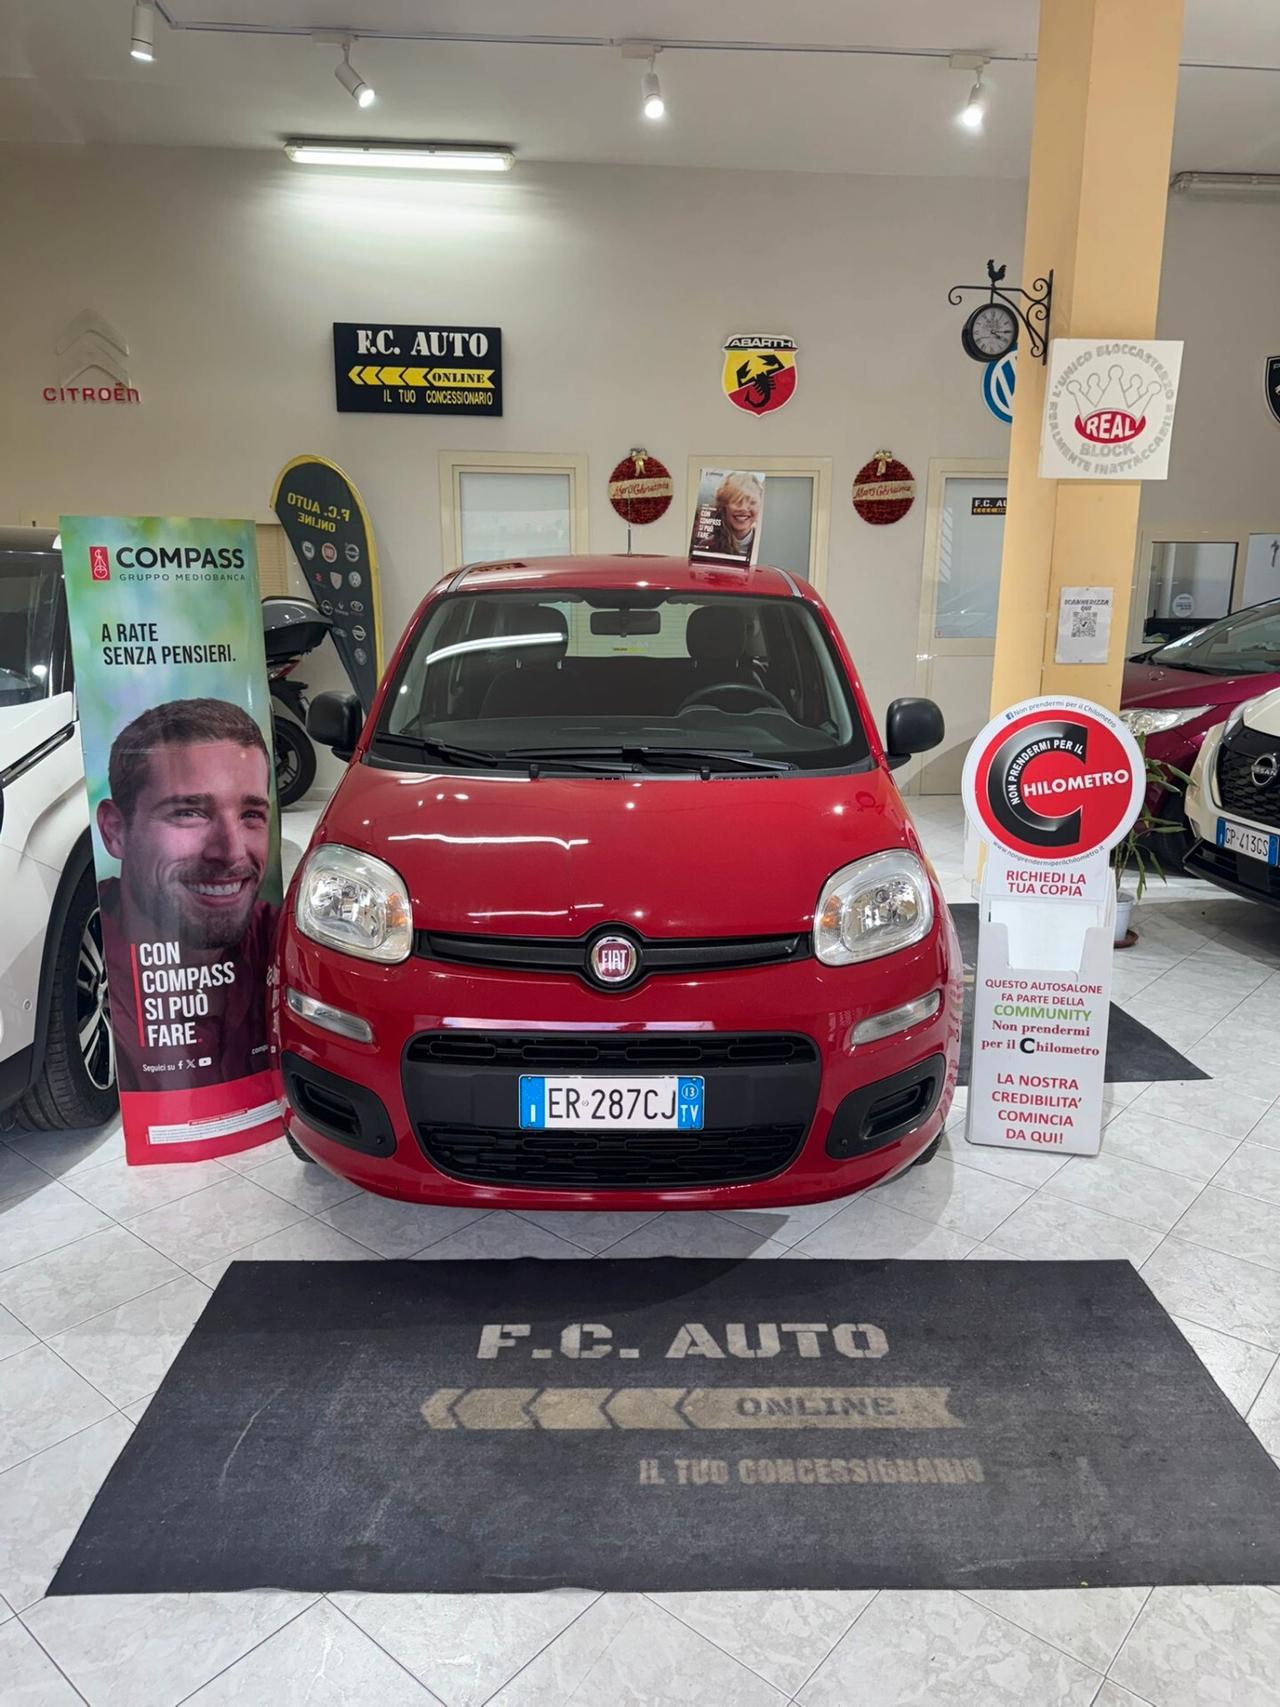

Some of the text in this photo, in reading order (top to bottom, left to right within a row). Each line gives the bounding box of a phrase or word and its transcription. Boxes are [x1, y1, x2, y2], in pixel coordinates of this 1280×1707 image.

[356, 329, 489, 358] F.C. AUTO
[730, 338, 792, 347] ABARTH
[432, 372, 485, 384] ONLINE
[383, 389, 493, 406] IL TUO CONCESSIONARIO
[1085, 413, 1136, 439] REAL
[1079, 441, 1136, 457] BLOCK
[116, 546, 245, 569] COMPASS
[119, 573, 246, 582] GRUPPO MEDIOBANCA
[101, 623, 159, 642] A RATE
[103, 644, 236, 665] SENZA PENSIERI.
[1028, 700, 1064, 711] prendermi
[1065, 701, 1078, 709] per
[1084, 704, 1117, 729] Chilometro
[1007, 739, 1084, 805] NON PRENDERMI PER IL
[1006, 870, 1087, 885] RICHIEDI LA
[1008, 882, 1083, 897] TUA COPIA
[139, 941, 181, 966] CON
[601, 949, 628, 970] FIAT
[142, 961, 236, 994] COMPASS
[985, 978, 1103, 994] QUESTO AUTOSALONE
[144, 989, 209, 1021] SI PUÒ
[1001, 992, 1085, 1006] FA PARTE DELLA
[994, 1004, 1092, 1022] COMMUNITY
[992, 1020, 1090, 1037] Non prendermi
[981, 1037, 1100, 1056] per il Chilometro
[142, 1063, 166, 1073] Seguici
[997, 1072, 1079, 1090] LA NOSTRA
[683, 1086, 696, 1097] 13
[991, 1090, 1082, 1109] CREDIBILITA'
[548, 1087, 581, 1119] ER
[591, 1088, 676, 1120] 287CJ
[679, 1104, 699, 1123] TV
[997, 1109, 1074, 1127] COMINCIA
[1006, 1128, 1064, 1144] DA QUI!
[475, 1322, 891, 1360] F.C. AUTO
[736, 1396, 899, 1417] ONLINE
[639, 1457, 986, 1485] IL TUO CONCESSIONARIO
